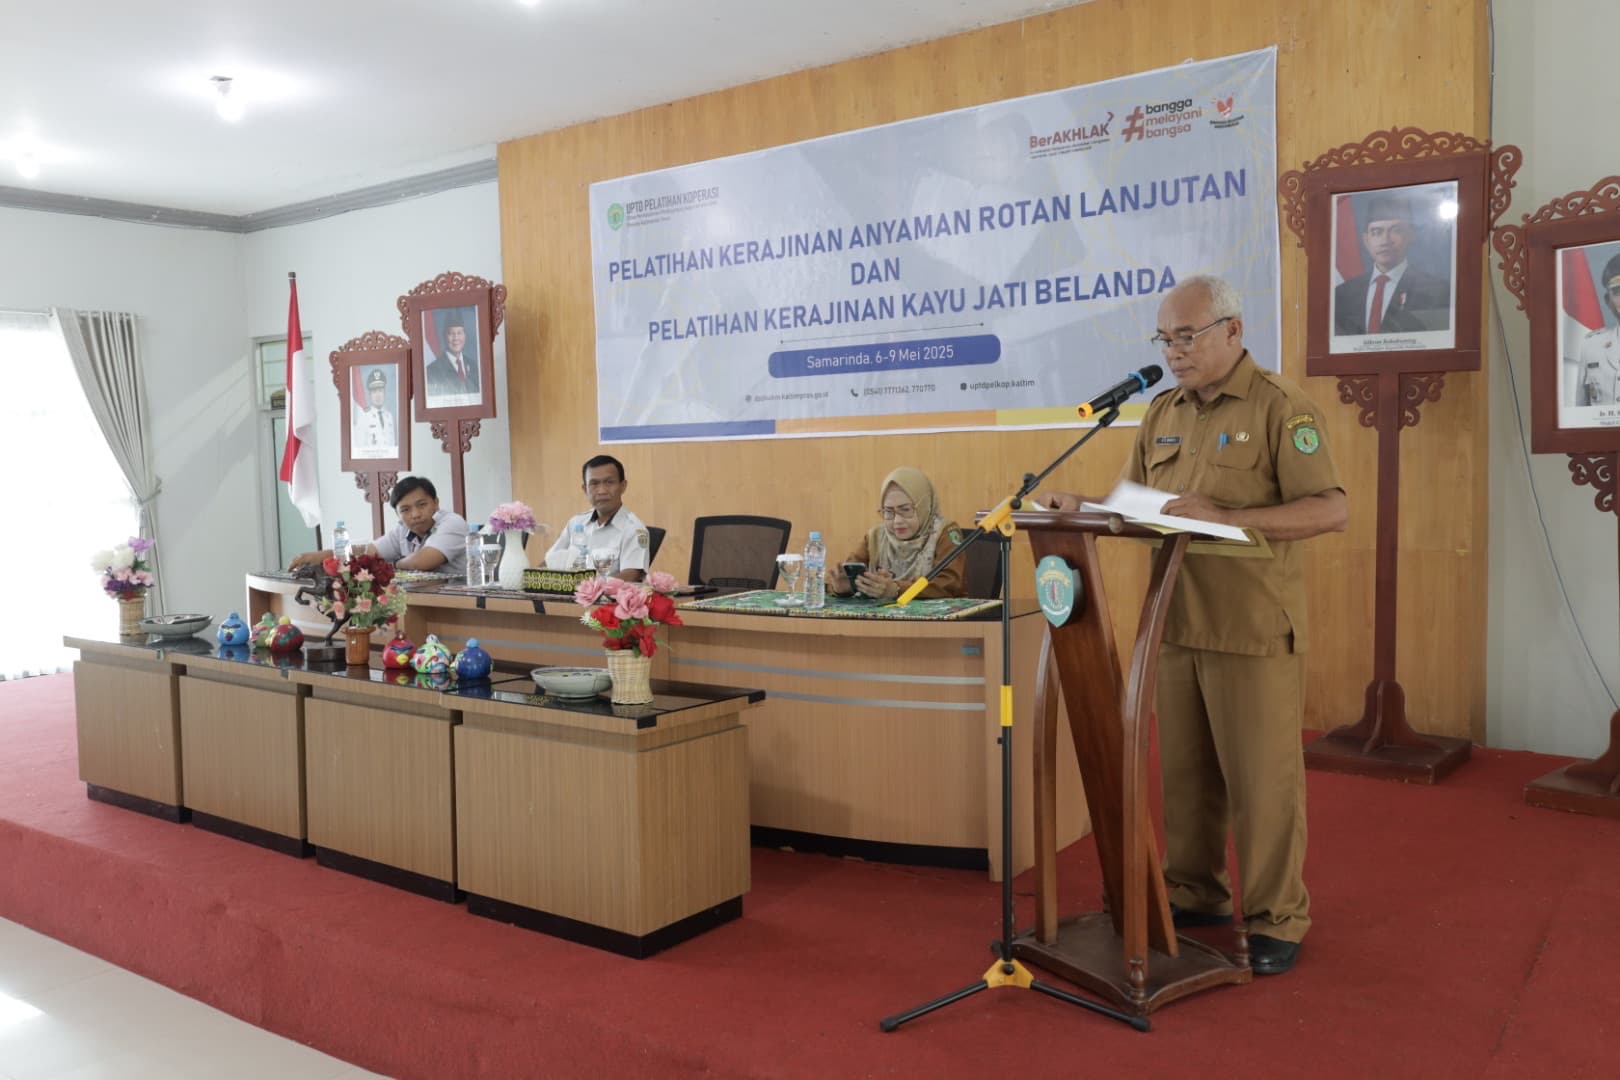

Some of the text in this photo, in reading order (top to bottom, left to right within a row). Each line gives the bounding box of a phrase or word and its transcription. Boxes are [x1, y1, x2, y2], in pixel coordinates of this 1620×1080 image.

[1146, 98, 1193, 115] bangga
[1146, 106, 1203, 127] melayani
[1029, 122, 1111, 149] BerAKHLAK
[1146, 122, 1192, 139] bangsa
[645, 192, 682, 211] PELATIHAN
[683, 187, 719, 203] KOPERASI
[609, 168, 1247, 282] PELATIHAN KERAJINAN ANYAMAN ROTAN LANJUTAN
[850, 256, 901, 287] DAN
[649, 265, 1177, 342] PELATIHAN KERAJINAN KAYU JATI BELANDA
[875, 349, 896, 364] 6-9
[899, 347, 920, 362] Mei
[923, 345, 954, 360] 2025
